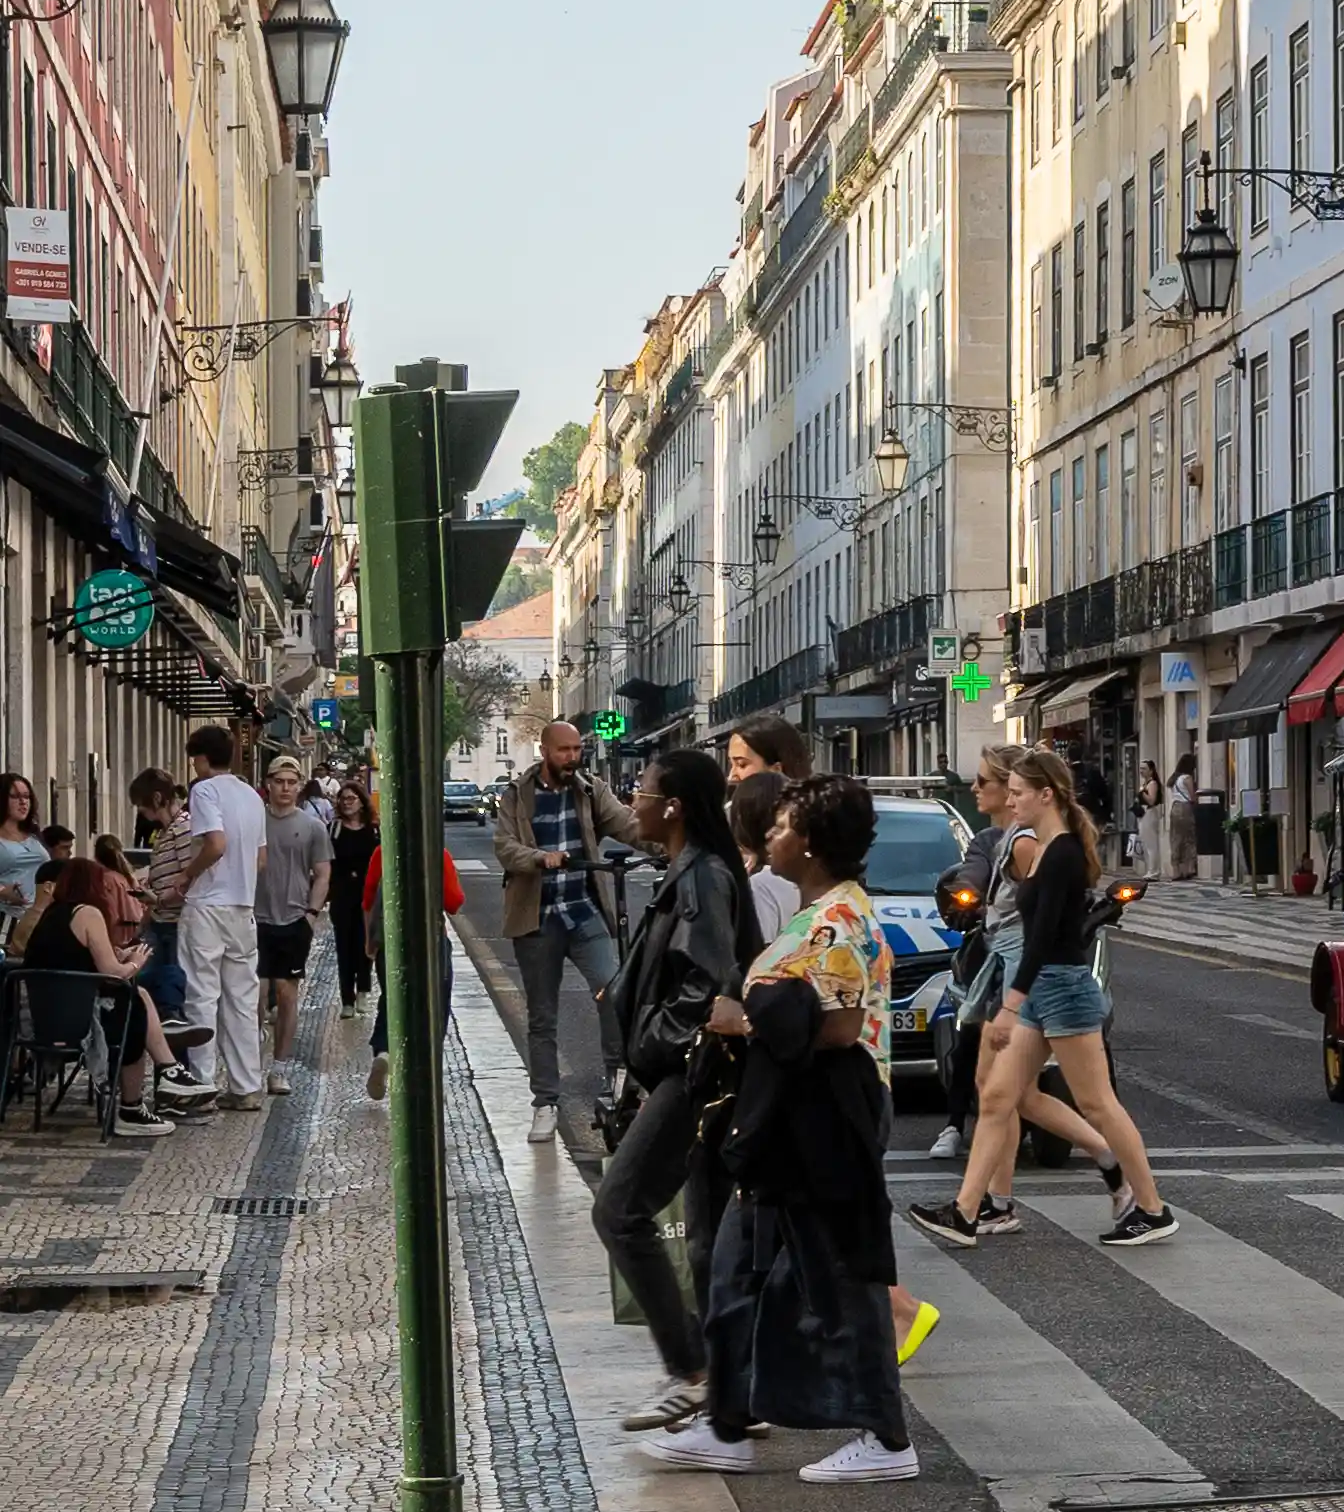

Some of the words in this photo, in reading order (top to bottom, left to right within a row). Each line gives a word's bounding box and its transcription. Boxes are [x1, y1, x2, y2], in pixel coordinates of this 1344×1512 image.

[14, 241, 67, 255] VENDE-SE
[318, 707, 331, 721] P
[893, 1011, 915, 1030] 63
